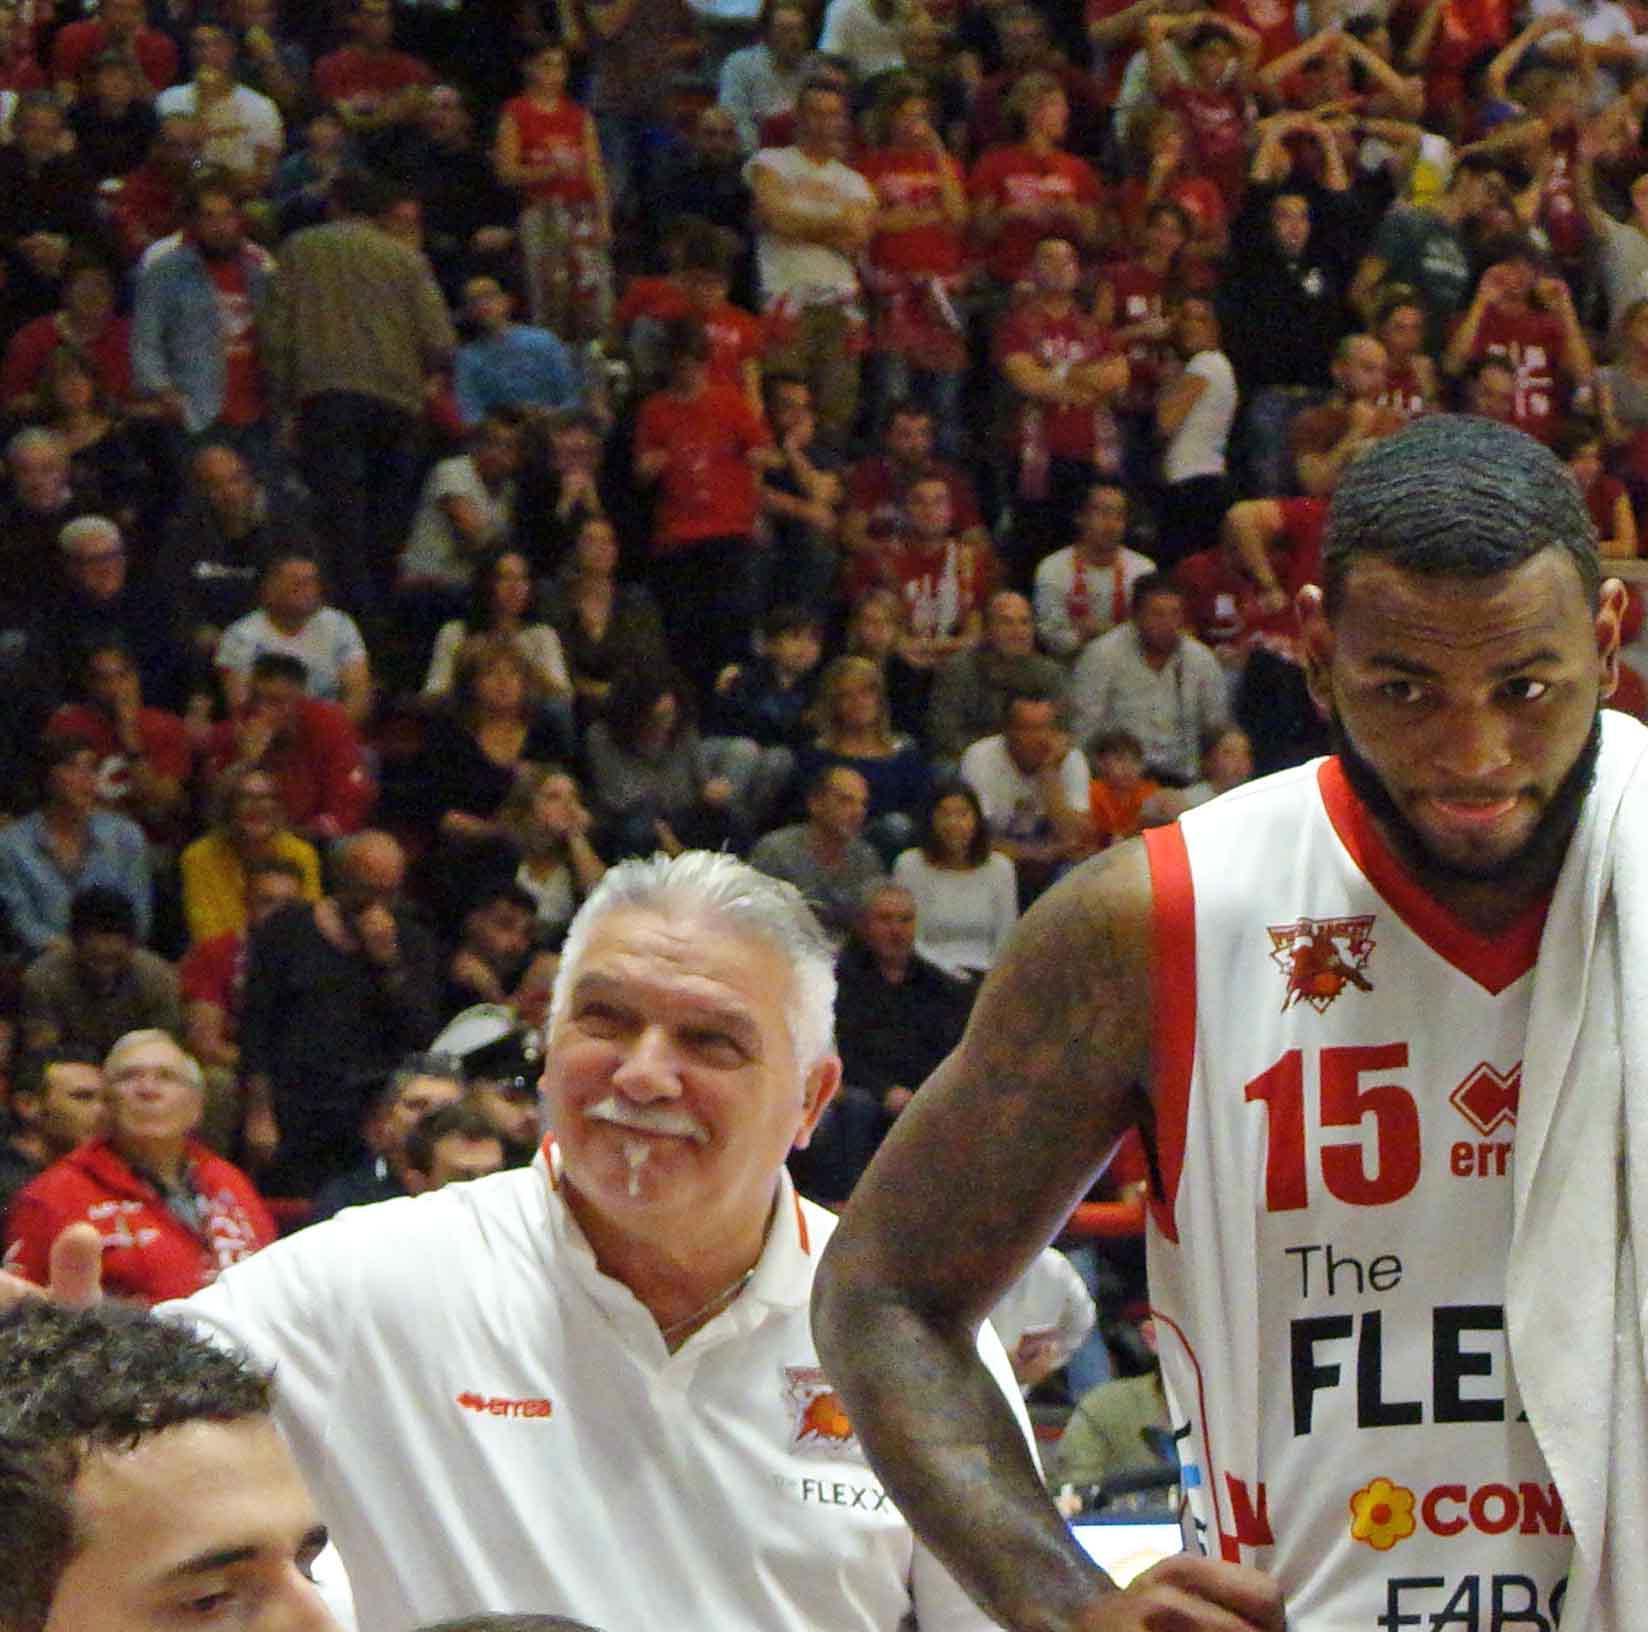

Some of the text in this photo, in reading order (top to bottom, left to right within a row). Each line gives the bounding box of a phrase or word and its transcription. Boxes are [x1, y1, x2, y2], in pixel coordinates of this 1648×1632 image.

[1245, 1042, 1422, 1212] 15
[1450, 1140, 1514, 1178] err
[1285, 1244, 1402, 1297] The
[1290, 1304, 1528, 1438] FLE
[1421, 1482, 1575, 1537] CON
